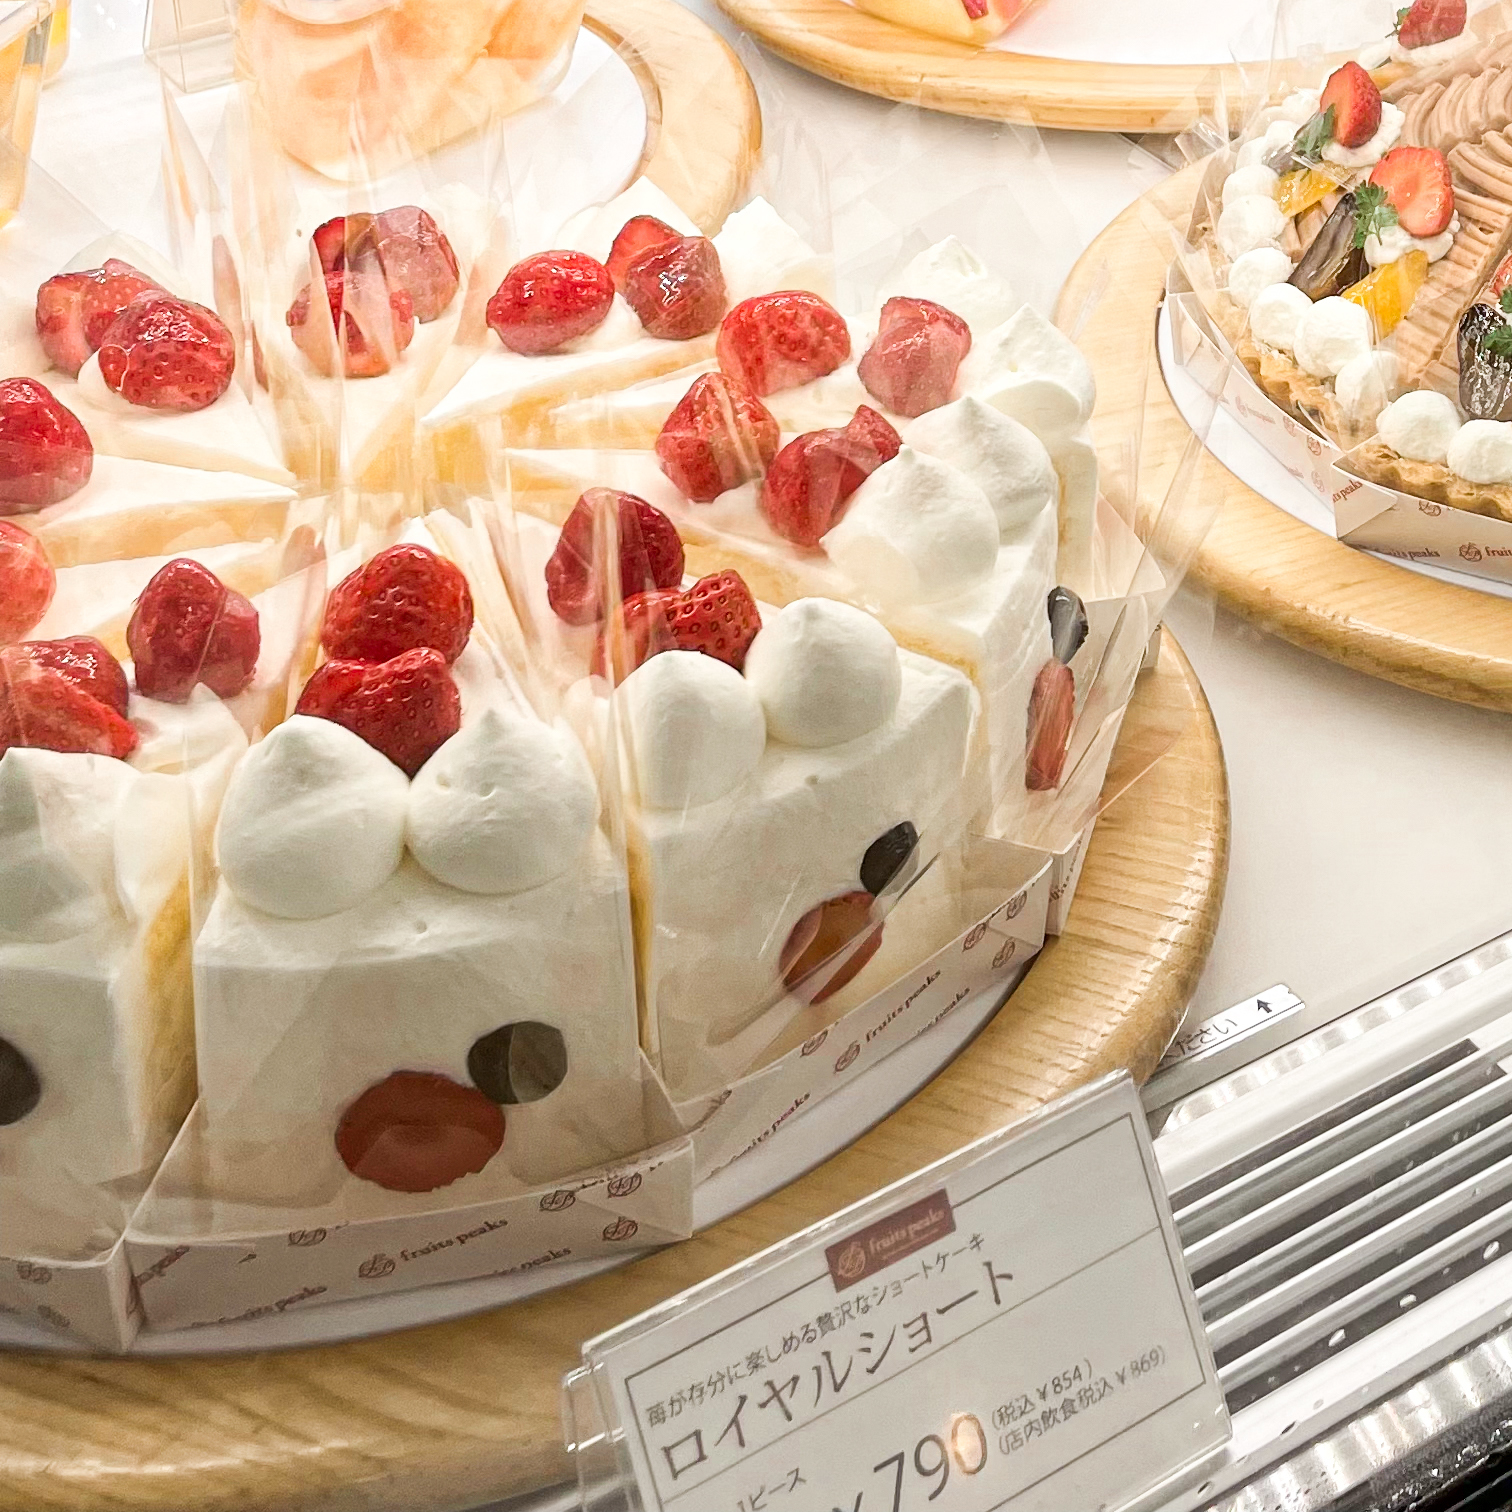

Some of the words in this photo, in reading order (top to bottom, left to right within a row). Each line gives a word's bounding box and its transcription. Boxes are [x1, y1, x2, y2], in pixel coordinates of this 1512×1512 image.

[903, 969, 941, 1009] peaks
[457, 1218, 508, 1246] peaks
[662, 1260, 1014, 1481] ロイヤルショート
[991, 1358, 1092, 1431] (税込¥854)
